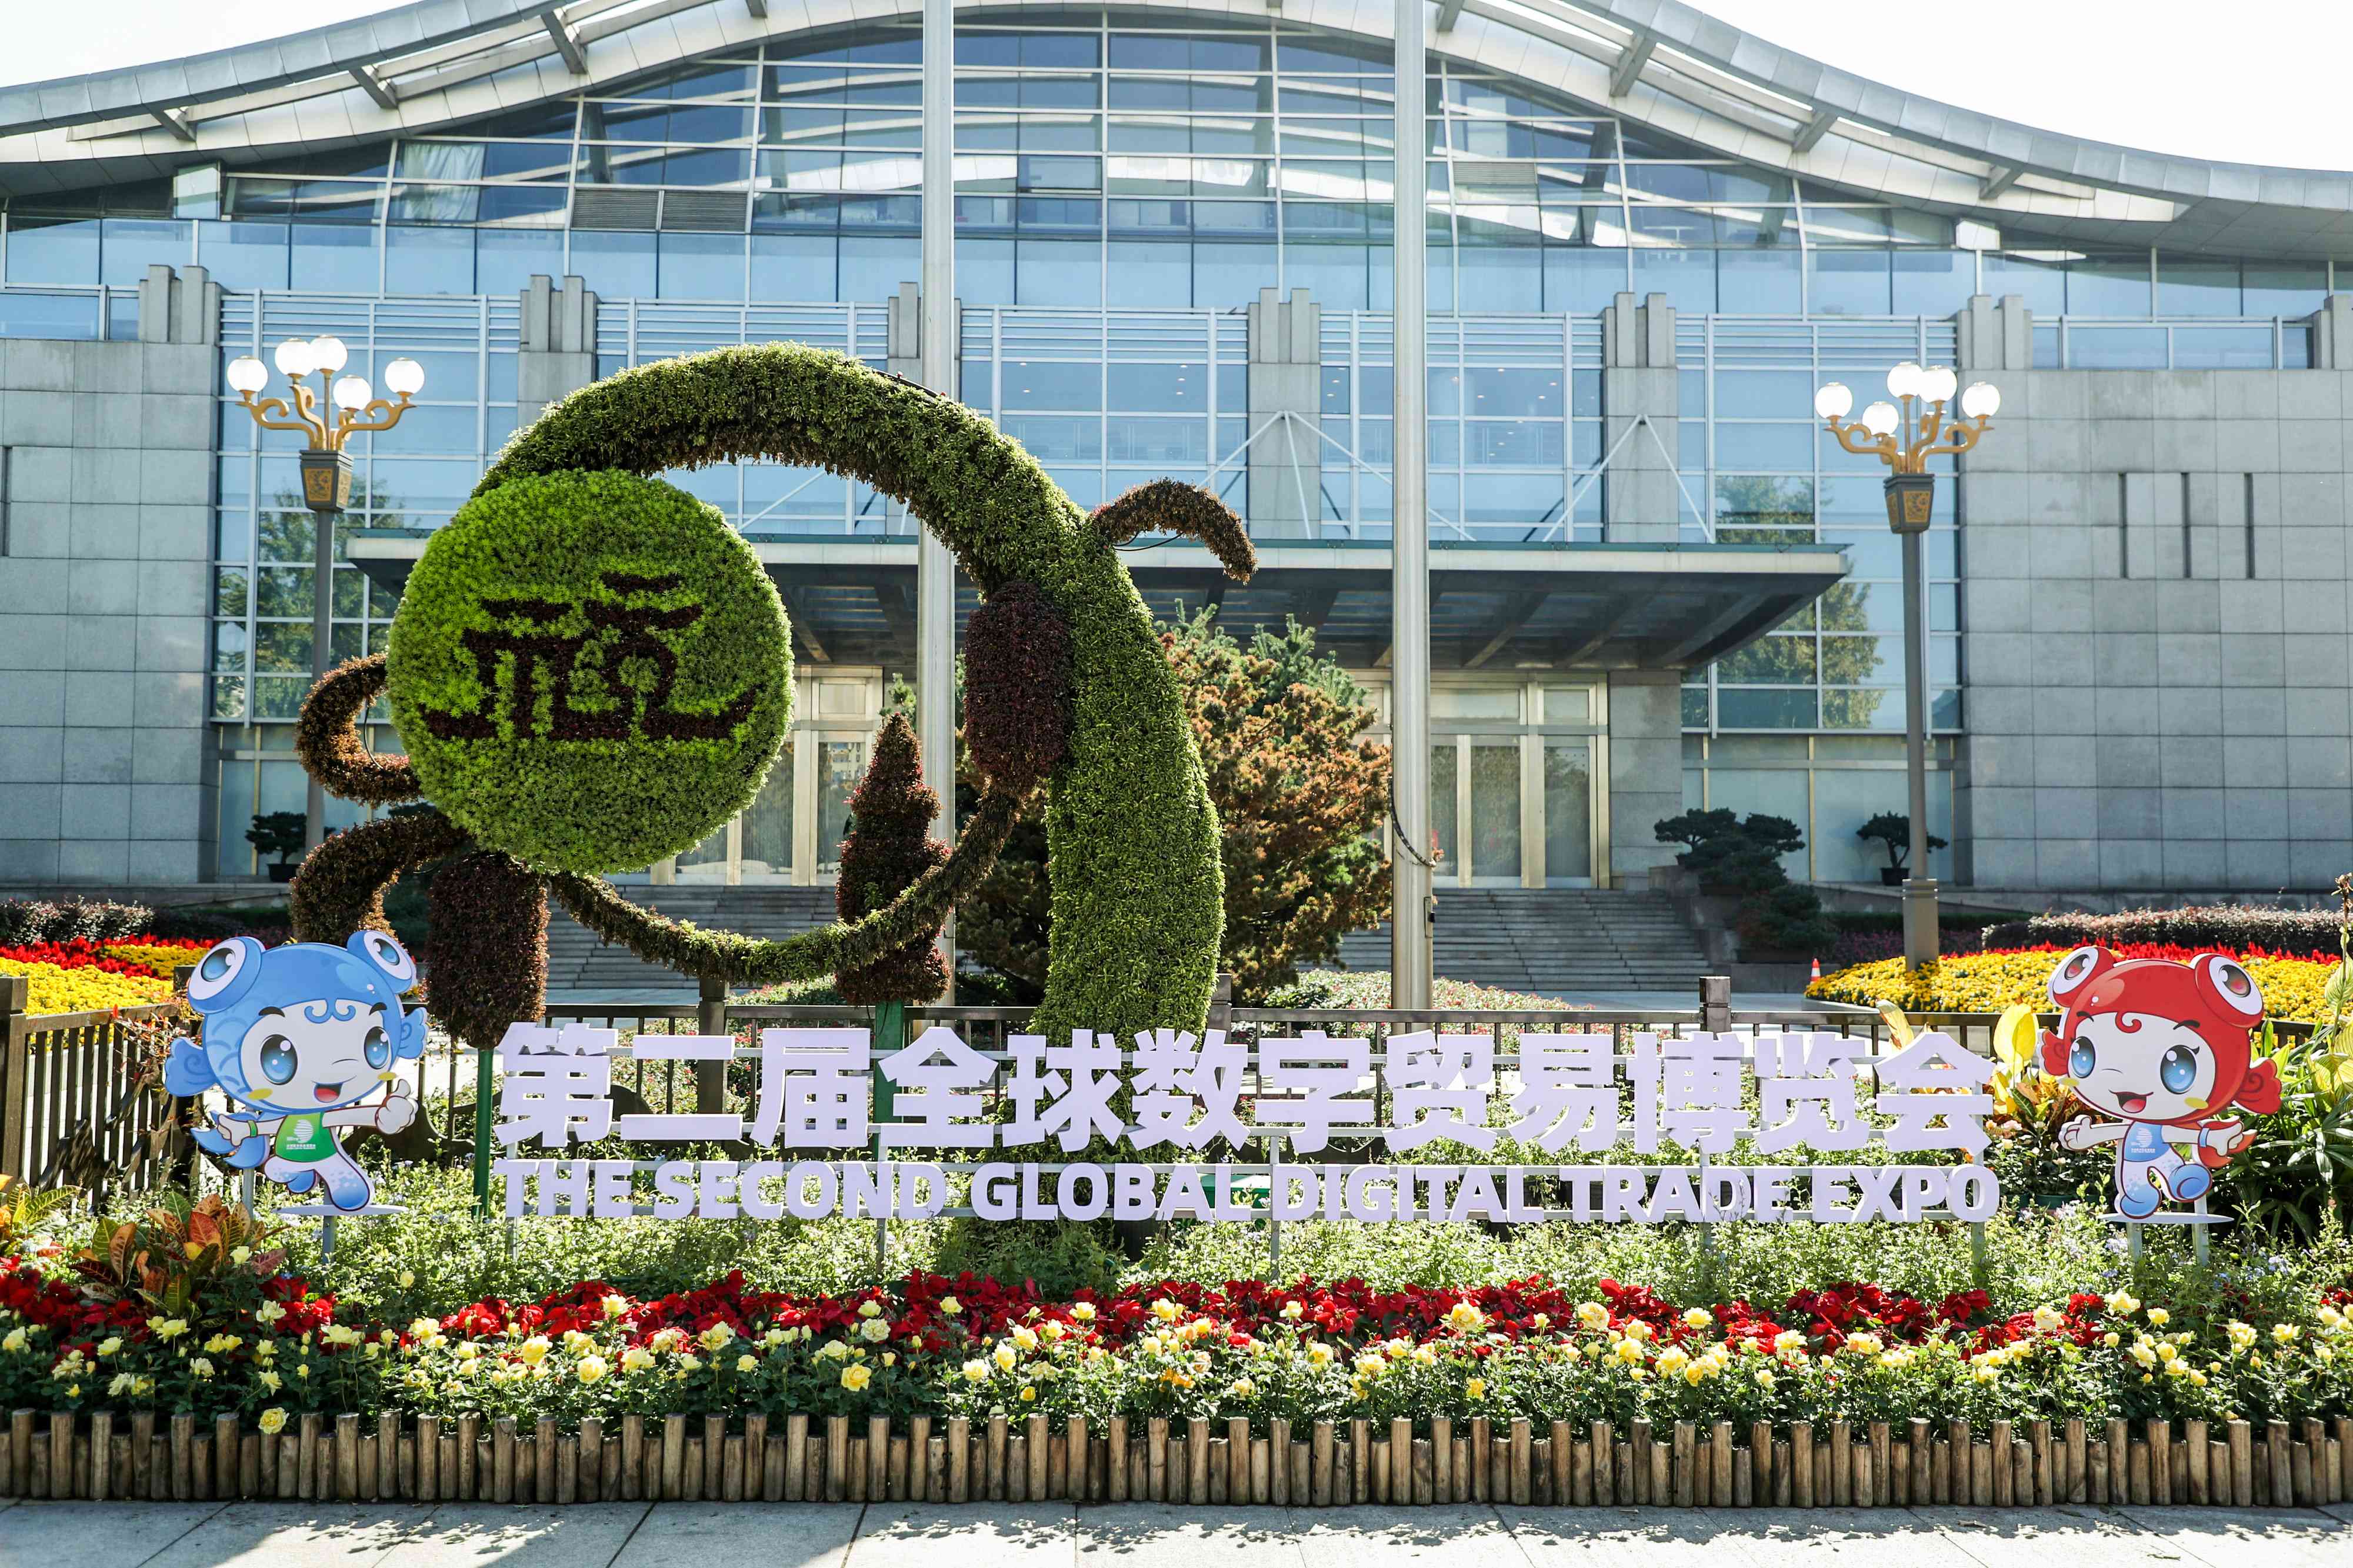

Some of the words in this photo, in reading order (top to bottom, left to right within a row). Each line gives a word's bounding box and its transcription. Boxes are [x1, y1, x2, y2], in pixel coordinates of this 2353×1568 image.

[493, 1022, 1995, 1156] 第二届全球数字贸易博览会
[493, 1159, 634, 1218] THE
[654, 1160, 946, 1220] SECOND
[971, 1162, 1251, 1222] GLOBAL
[1273, 1163, 1544, 1223] DIGITAL
[1559, 1165, 1793, 1223] TRADE
[1812, 1163, 2000, 1223] EXPO
